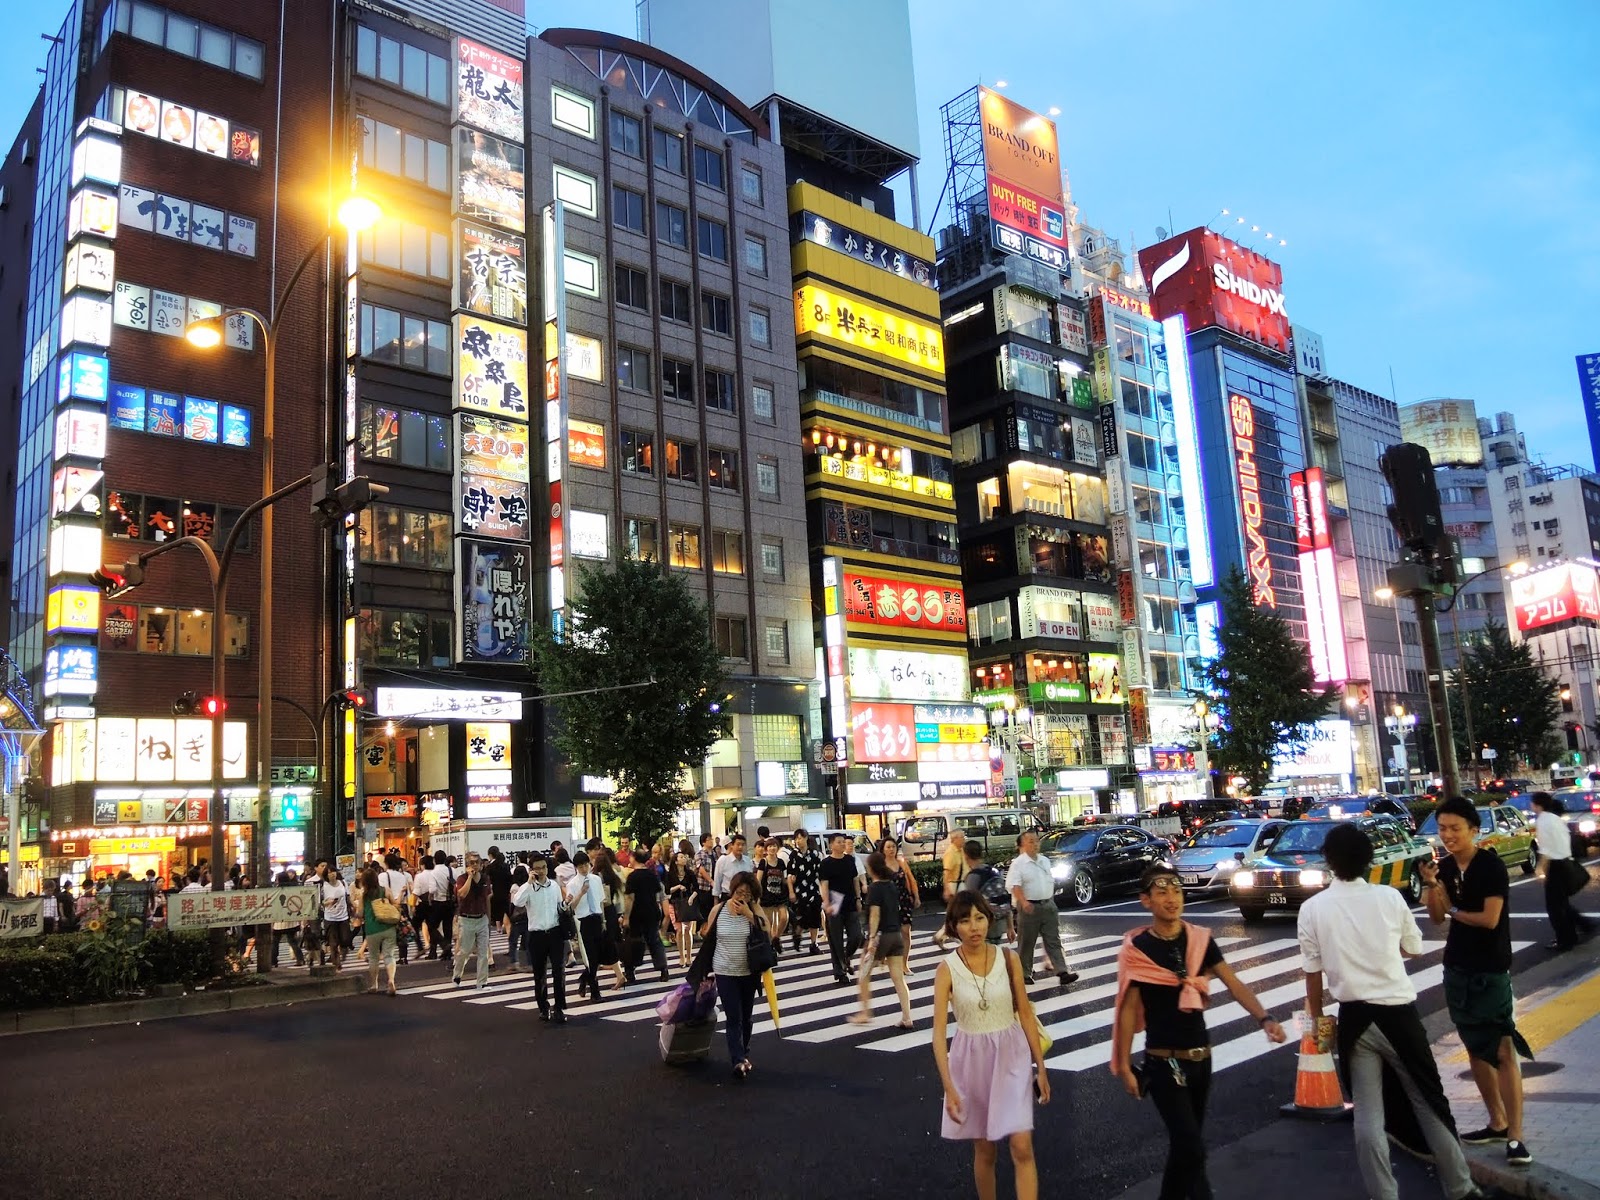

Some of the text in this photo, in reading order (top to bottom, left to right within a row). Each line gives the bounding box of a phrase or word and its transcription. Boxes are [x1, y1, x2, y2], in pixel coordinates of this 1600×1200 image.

[461, 43, 478, 60] 9F
[461, 65, 520, 110] 龍太
[987, 122, 1055, 164] BRAND OFF
[1007, 146, 1040, 167] TOKYO
[122, 187, 140, 199] 7F
[992, 183, 1037, 214] DUTY FREE
[137, 195, 234, 247] かまどか
[844, 234, 903, 273] かまくら
[466, 248, 517, 284] 吉宗
[116, 283, 131, 294] 6F
[1213, 262, 1288, 318] SHIDAX
[814, 304, 830, 324] 8F
[884, 328, 940, 361] 昭和商店街
[464, 373, 483, 394] 6F
[462, 393, 489, 407] 110席
[464, 434, 525, 459] 天空の雫
[1231, 395, 1276, 610] SHIDAX
[463, 511, 480, 530] 4F
[487, 521, 508, 531] SUIEN
[1036, 587, 1074, 599] BRAND OFF
[492, 568, 514, 641] 隠れや
[1089, 605, 1113, 617] 高価買取
[1523, 597, 1568, 627] アコム
[104, 627, 134, 635] GARDEN
[105, 620, 134, 629] DRAGON
[1051, 625, 1079, 636] OPEN
[470, 736, 505, 763] 楽宴
[940, 784, 971, 796] BRITISH
[971, 783, 986, 794] PUB
[188, 801, 203, 820] 大陸
[181, 893, 273, 914] 路上喫煙禁止
[11, 913, 38, 930] 新宿区
